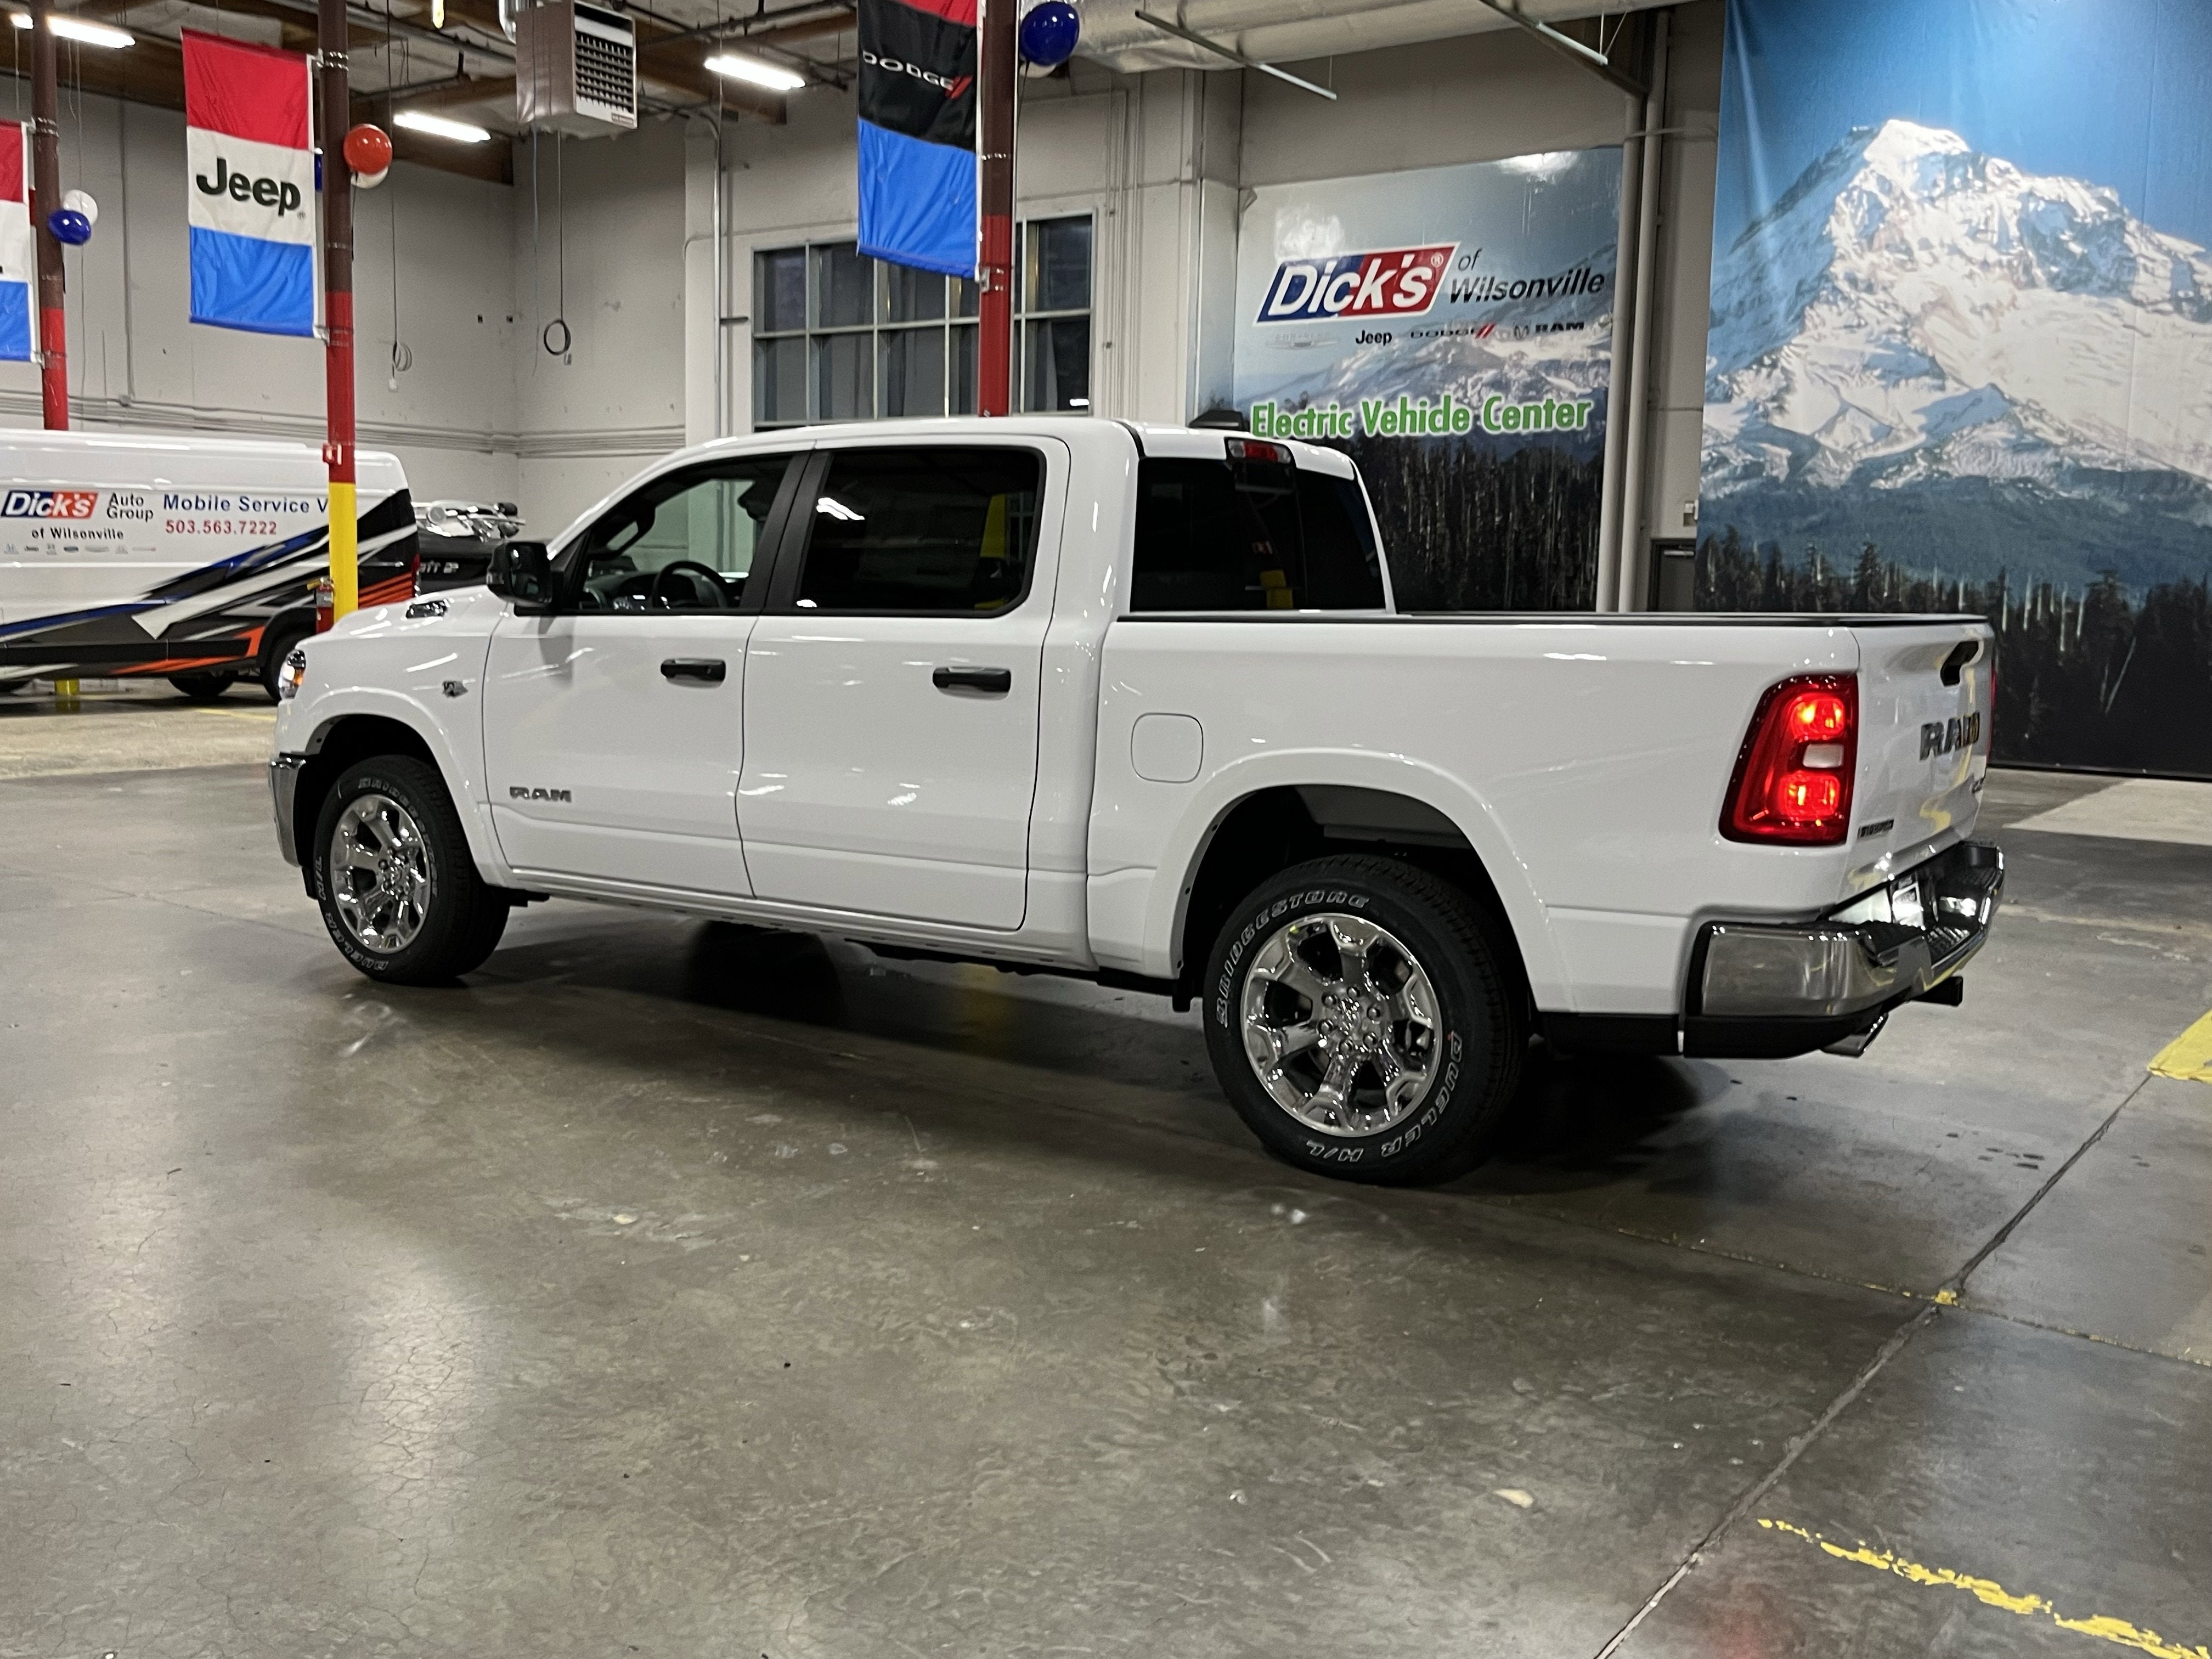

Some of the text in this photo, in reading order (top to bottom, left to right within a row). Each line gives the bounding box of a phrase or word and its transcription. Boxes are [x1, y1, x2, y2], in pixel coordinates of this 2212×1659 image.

[862, 50, 953, 91] DODGE
[196, 156, 301, 217] Jeep
[1267, 248, 1482, 316] Dick's of
[1449, 268, 1605, 303] Wilsonville
[1356, 330, 1392, 346] Jeep
[1252, 395, 1592, 437] Electric Vehicle Center
[5, 492, 92, 517] Dick's
[109, 493, 144, 507] Auto
[163, 494, 231, 511] Mobile
[238, 495, 311, 514] Service
[106, 505, 154, 522] Group
[31, 526, 125, 540] of Wilsonville
[165, 519, 278, 535] 503.563.7222
[1919, 711, 1980, 761] RAM
[509, 787, 572, 803] RAM
[1216, 889, 1370, 1029] BRIDGESTONE
